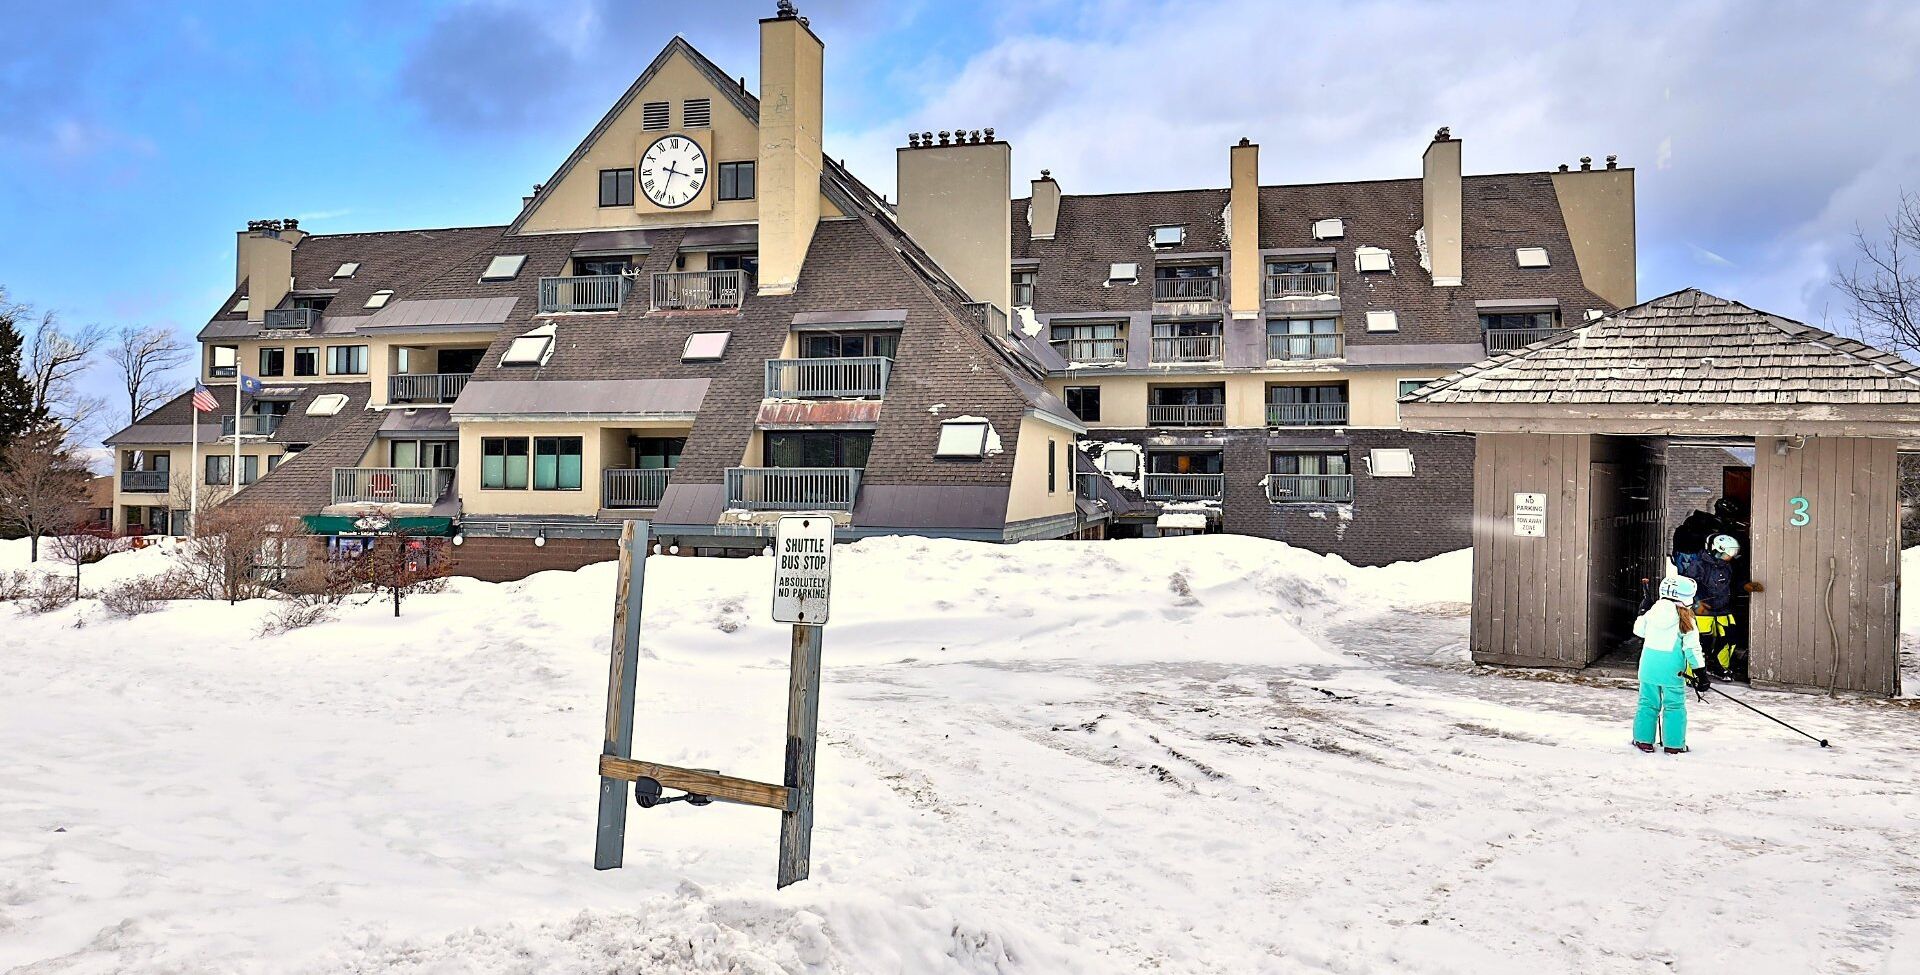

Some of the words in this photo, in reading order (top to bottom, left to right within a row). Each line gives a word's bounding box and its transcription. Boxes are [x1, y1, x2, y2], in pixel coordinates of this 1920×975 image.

[656, 142, 666, 154] XI
[670, 139, 679, 149] XII
[646, 154, 656, 163] X
[643, 168, 652, 176] IX
[668, 195, 675, 204] VI
[682, 192, 689, 201] V
[1790, 496, 1810, 526] 3
[785, 538, 824, 553] SHUTTLE
[781, 555, 800, 570] BUS
[804, 555, 826, 570] STOP
[779, 577, 825, 588] ABSOLUTELY
[778, 588, 789, 597] NO
[792, 588, 825, 598] PARKING
